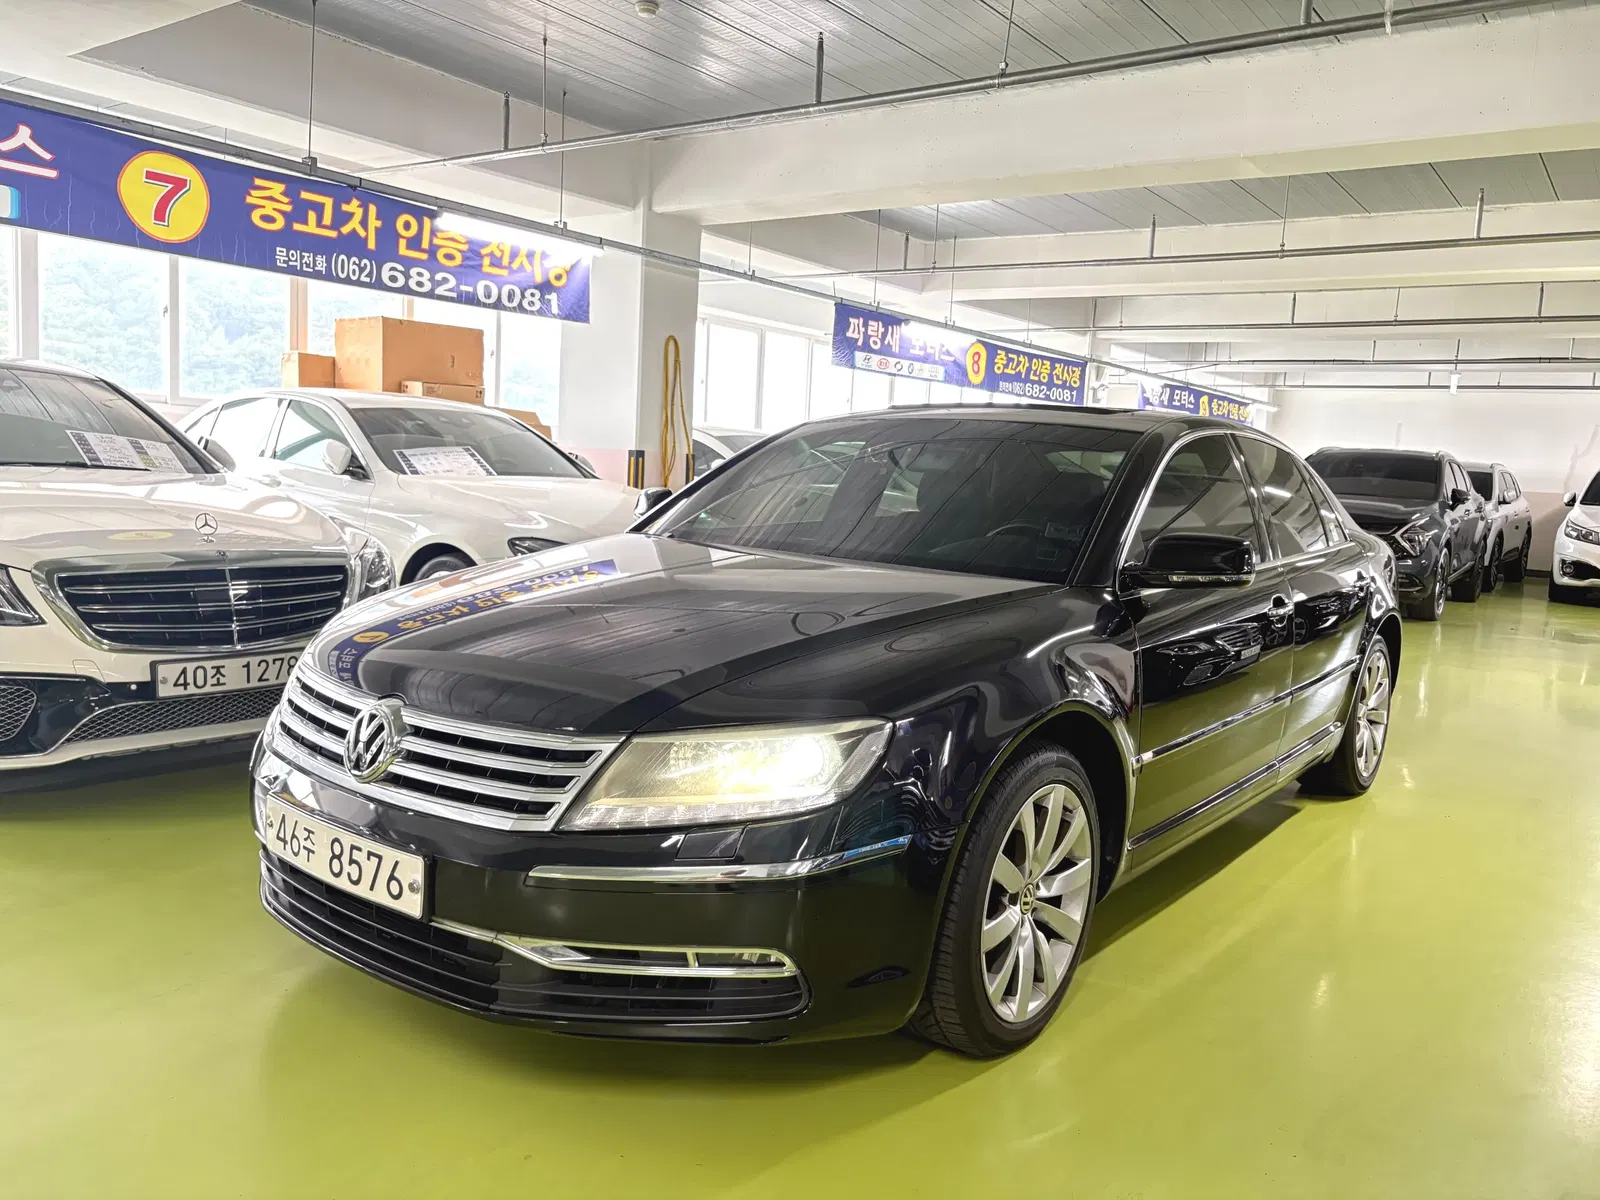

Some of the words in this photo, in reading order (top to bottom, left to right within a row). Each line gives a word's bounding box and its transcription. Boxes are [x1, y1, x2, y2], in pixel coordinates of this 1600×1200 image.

[144, 168, 191, 227] 7
[245, 177, 383, 251] 중고차
[395, 213, 470, 268] 인증
[274, 246, 327, 275] 문의전화
[331, 252, 377, 284] (062)
[380, 261, 559, 316] 682-0081
[846, 317, 900, 354] 파랑새
[971, 351, 981, 376] 8
[994, 349, 1029, 379] 중고차
[1029, 358, 1051, 383] 인증
[1053, 363, 1081, 388] 전시장
[1025, 383, 1077, 402] 682-0081
[1172, 390, 1195, 409] 모터스
[1212, 398, 1229, 417] 중고차
[173, 665, 226, 691] 40조
[242, 656, 299, 684] 1278
[276, 813, 315, 863] 46주
[329, 837, 404, 900] 8576
